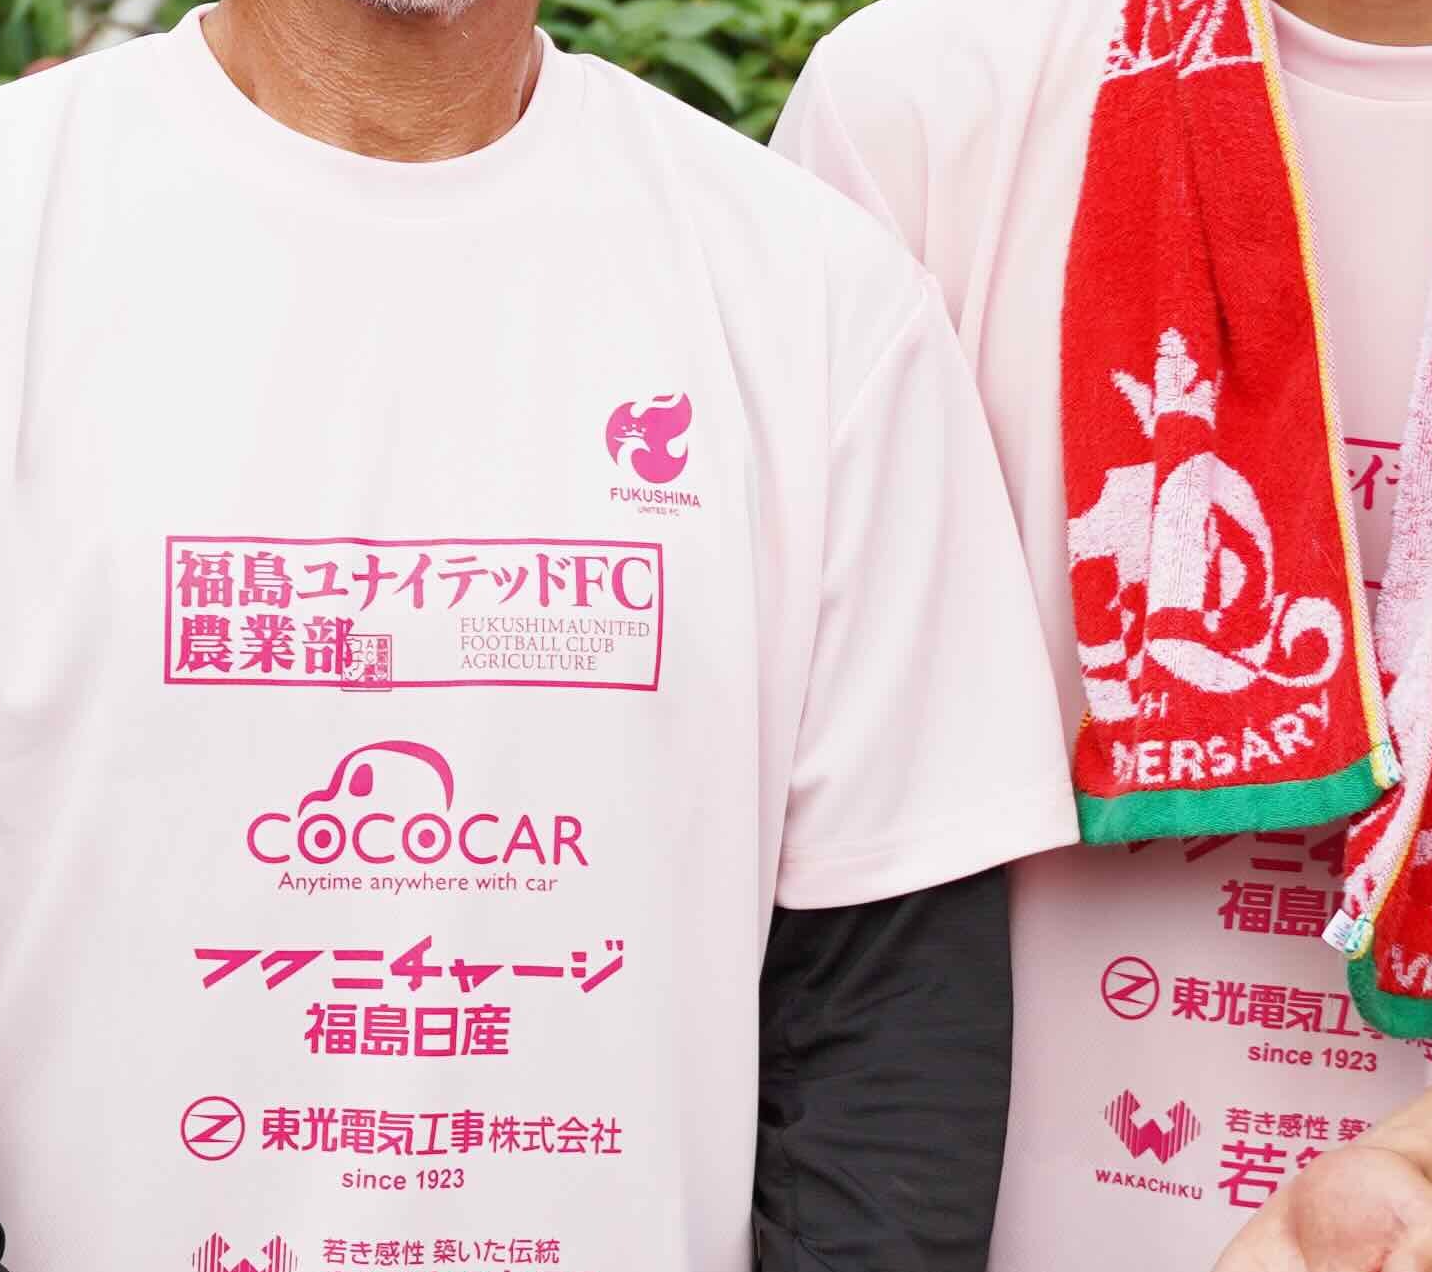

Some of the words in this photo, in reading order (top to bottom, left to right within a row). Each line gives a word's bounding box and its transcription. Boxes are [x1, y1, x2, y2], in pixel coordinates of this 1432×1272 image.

[610, 487, 702, 508] FUKUSHIMA
[175, 548, 654, 611] 福島ユナイテッドFC
[175, 614, 355, 675] 農業部
[459, 635, 561, 653] FOOTBALL
[565, 637, 615, 655] CLUB
[460, 653, 598, 671] AGRICULTURE
[246, 811, 589, 867] COCOCAR
[277, 871, 363, 895] Anytime
[369, 871, 469, 895] anywhere
[475, 871, 518, 892] with
[525, 876, 559, 893] car
[304, 1003, 512, 1057] 福島日産
[1247, 1042, 1313, 1066] since
[1321, 1047, 1378, 1072] 1923
[261, 1107, 623, 1157] 東光電気工事株式会社
[1224, 1107, 1330, 1142] 若き感性
[341, 1167, 407, 1192] since
[416, 1167, 465, 1191] 1923
[1095, 1168, 1203, 1201] WAKACHIKU
[322, 1237, 425, 1265] 若き感性
[433, 1237, 561, 1266] 築いた伝統
